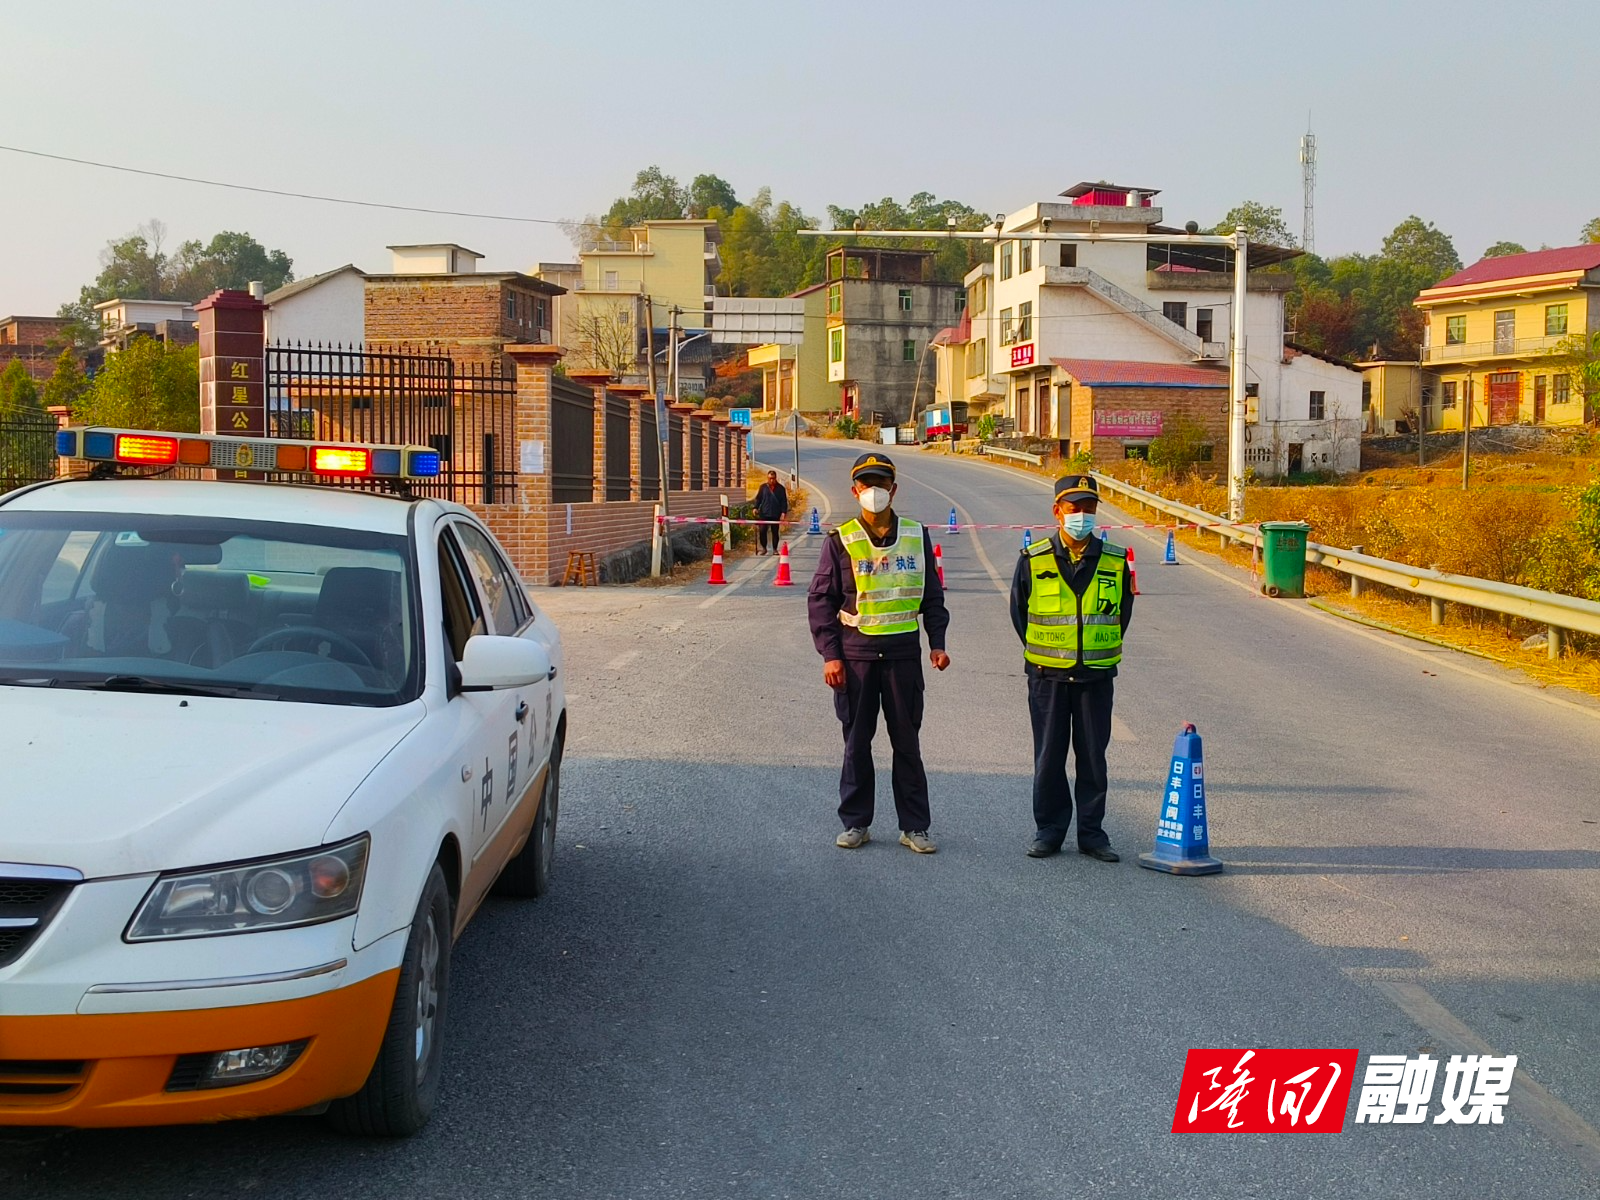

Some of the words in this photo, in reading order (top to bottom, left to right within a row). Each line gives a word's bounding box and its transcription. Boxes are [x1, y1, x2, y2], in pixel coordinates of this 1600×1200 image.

[896, 555, 917, 571] 执法
[1094, 631, 1109, 643] JIAO
[1193, 784, 1203, 841] 日丰管
